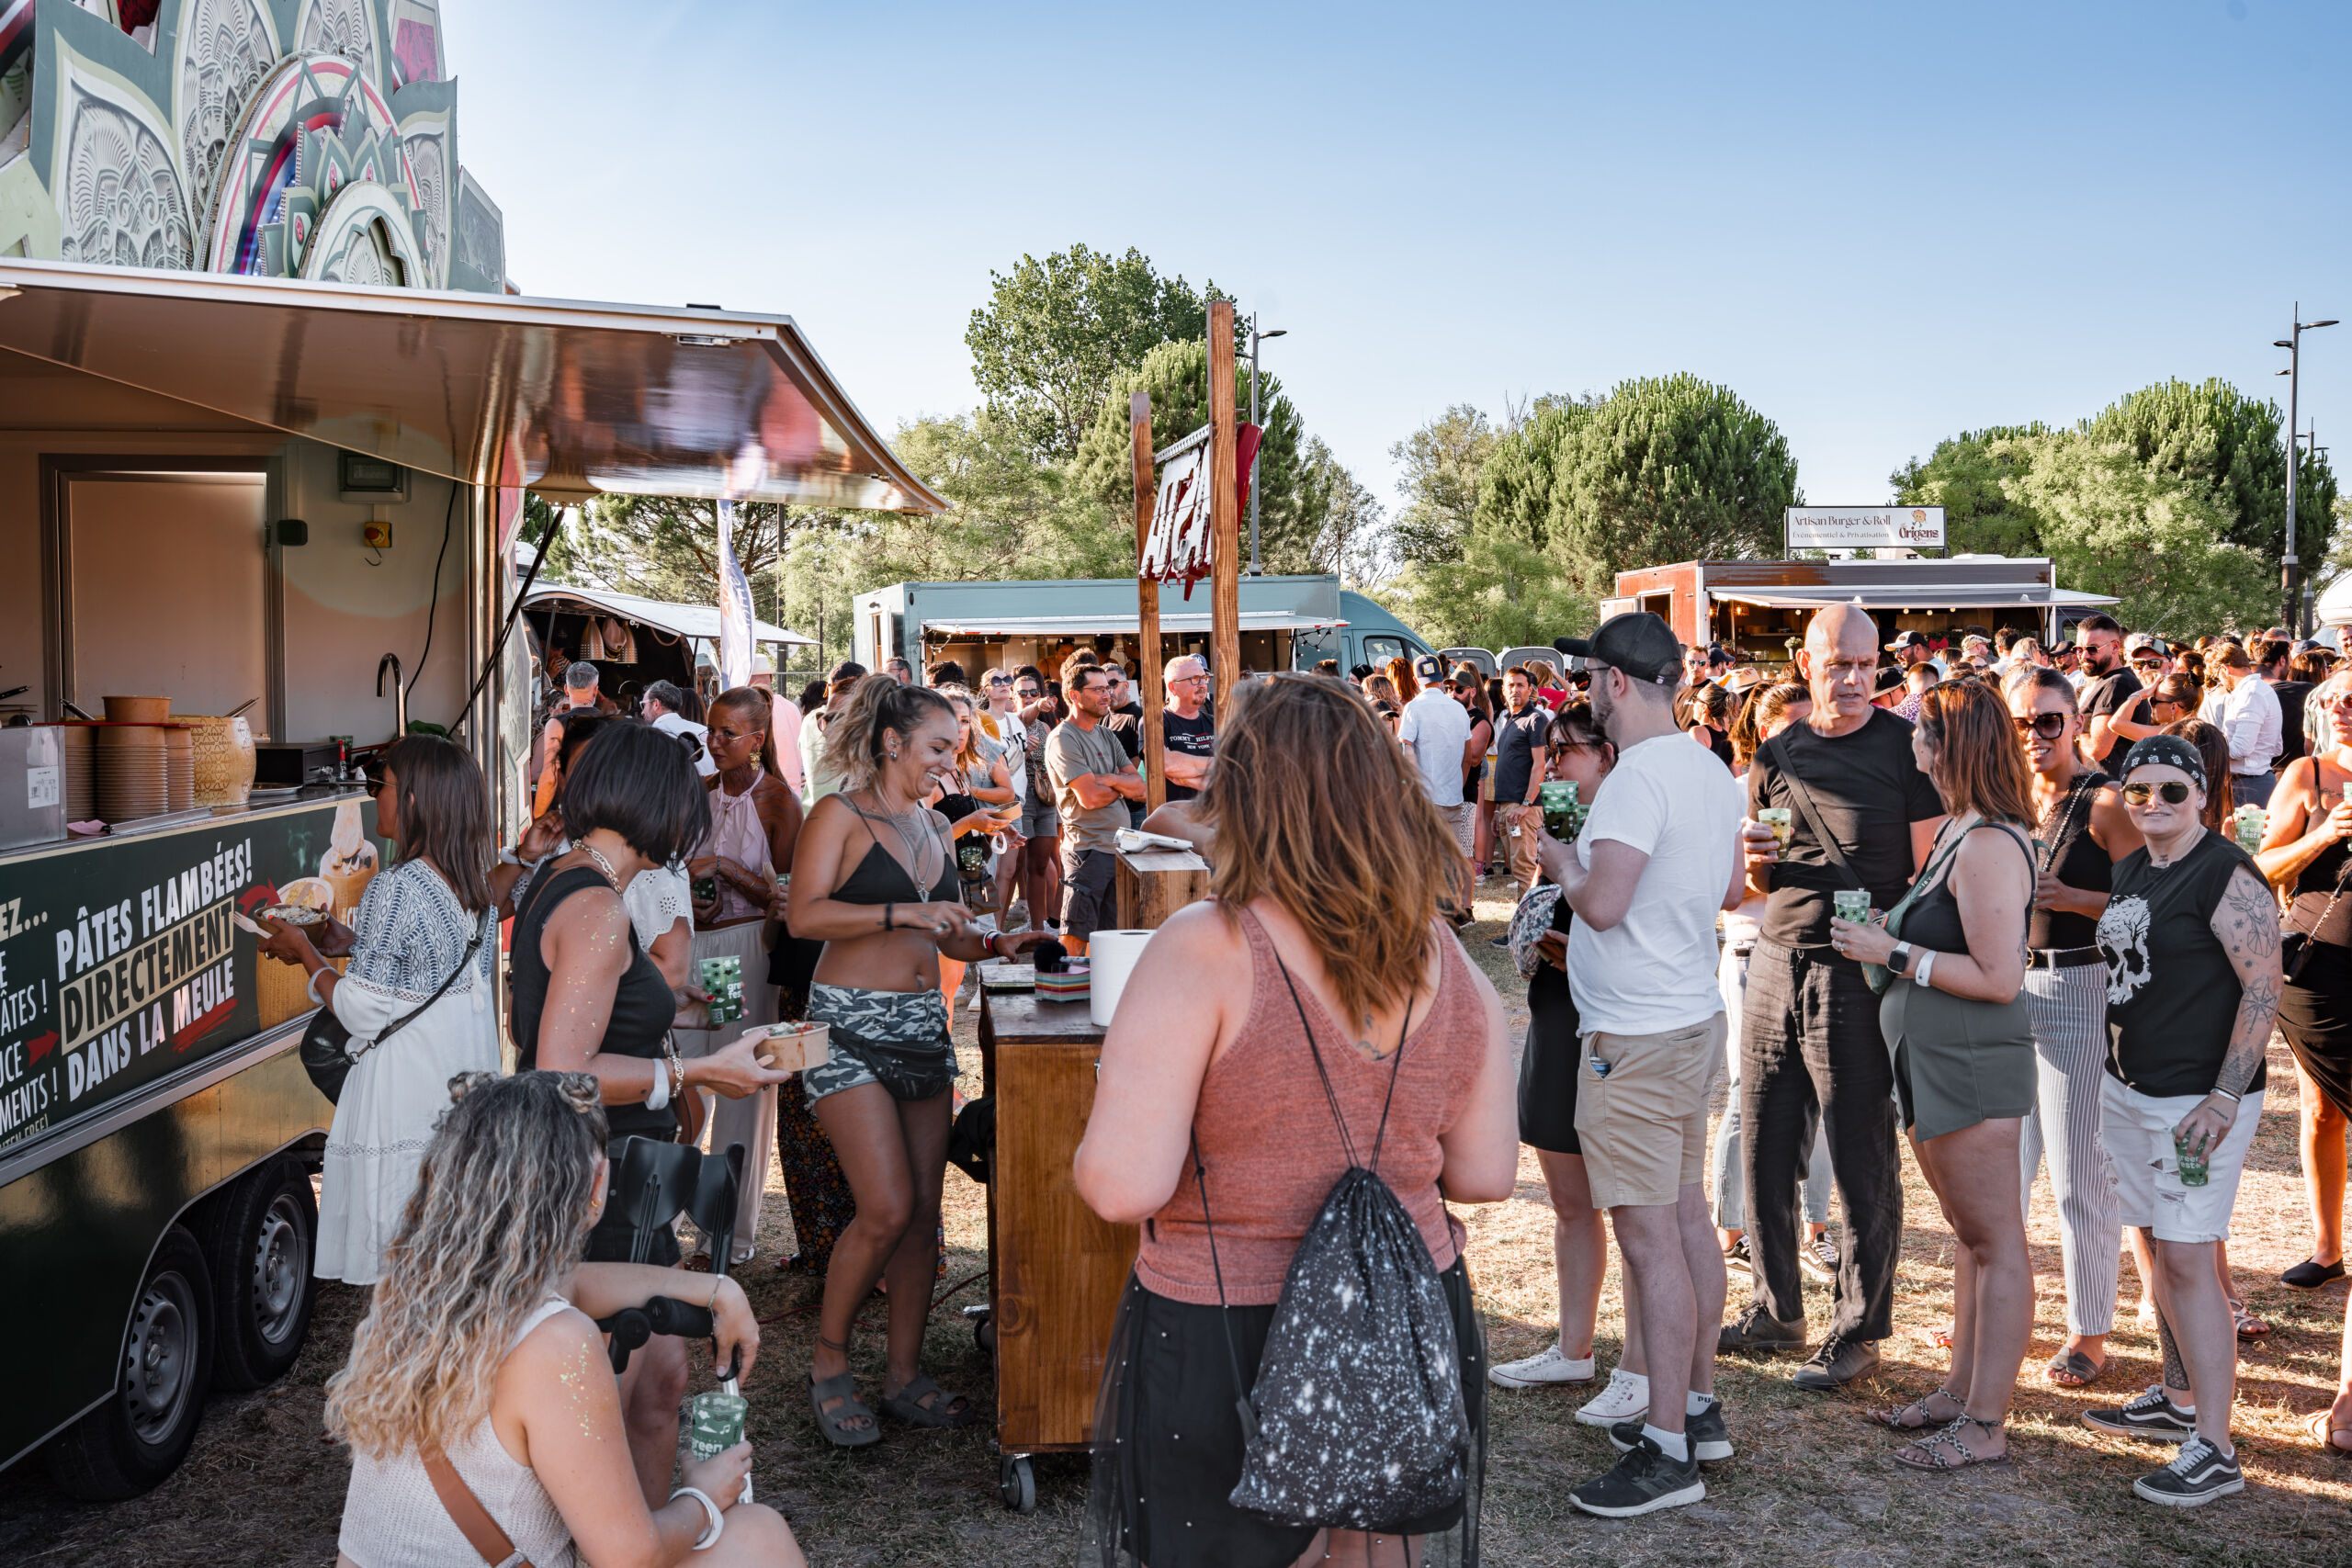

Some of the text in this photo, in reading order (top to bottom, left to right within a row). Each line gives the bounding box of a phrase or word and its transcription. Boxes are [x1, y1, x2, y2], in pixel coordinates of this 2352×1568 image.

[1793, 515, 1891, 528] Artisan Burger & Roll
[1899, 526, 1939, 541] Origens
[56, 838, 253, 983] PÂTES FLAMBÉES!
[62, 900, 233, 1045] DIRECTEMENT
[68, 956, 234, 1102] DANS LA MEULE
